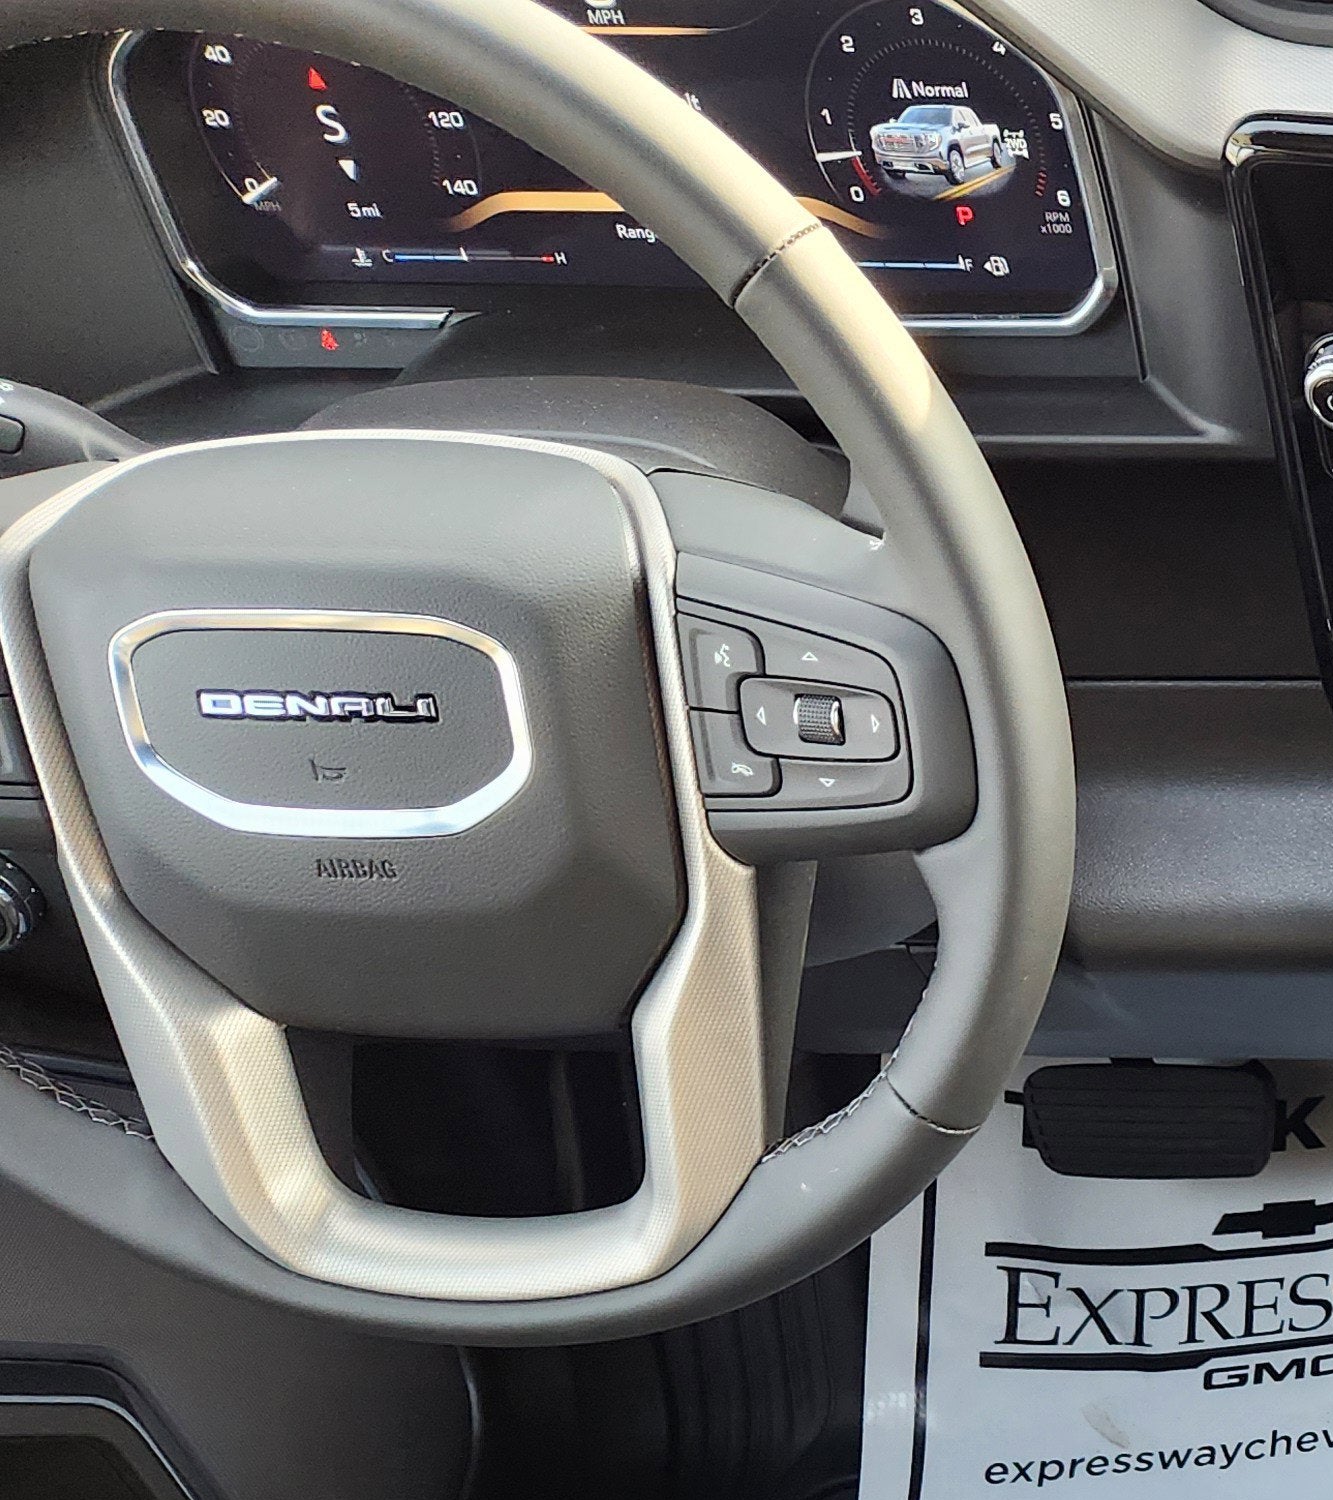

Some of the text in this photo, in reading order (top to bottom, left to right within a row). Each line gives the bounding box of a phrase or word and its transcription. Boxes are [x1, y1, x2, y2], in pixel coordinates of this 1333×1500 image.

[587, 9, 625, 25] MPH
[909, 8, 924, 26] 3
[840, 35, 856, 53] 2
[992, 41, 1006, 55] 4
[204, 44, 232, 64] 40
[912, 80, 969, 99] Normal
[202, 109, 232, 129] 20
[315, 104, 349, 144] S
[428, 111, 466, 129] 120
[820, 108, 833, 125] 1
[1049, 113, 1064, 131] 5
[442, 179, 479, 196] 140
[849, 185, 865, 203] 0
[1057, 190, 1072, 207] 6
[956, 206, 974, 225] P
[1045, 212, 1071, 223] RPM
[615, 222, 660, 243] Rang
[1040, 224, 1074, 235] x1000
[554, 251, 568, 266] H
[197, 689, 439, 723] DENALI
[316, 858, 398, 879] AIRBAG
